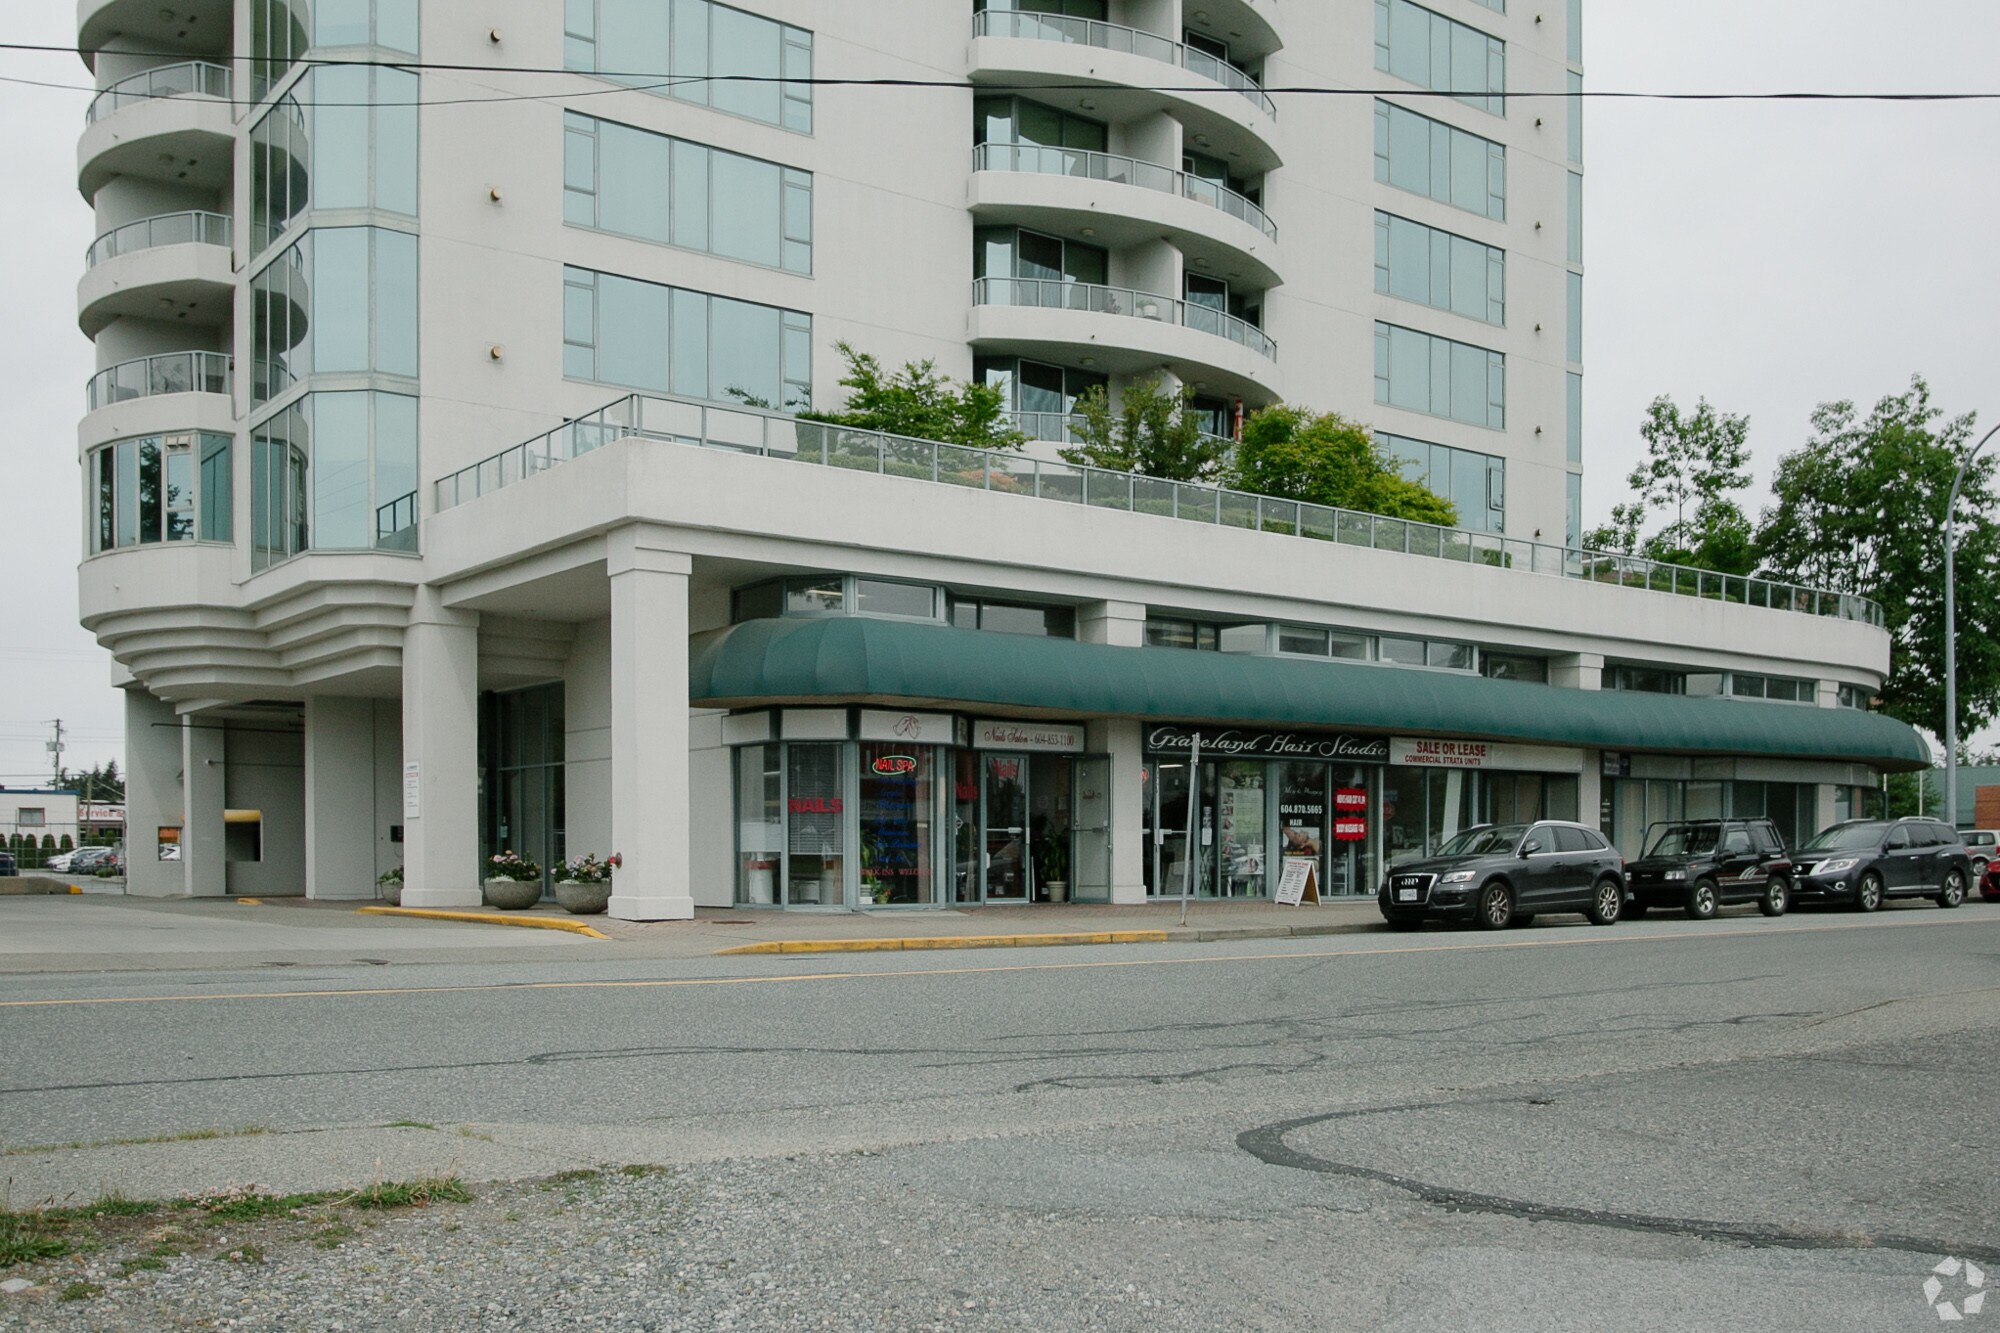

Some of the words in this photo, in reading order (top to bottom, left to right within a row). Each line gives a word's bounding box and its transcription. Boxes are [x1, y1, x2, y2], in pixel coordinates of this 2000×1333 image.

[1149, 727, 1271, 754] Graeland
[1265, 734, 1319, 753] Hair
[1319, 734, 1387, 756] Studio
[1416, 741, 1440, 754] SALE
[1442, 742, 1455, 755] OR
[1458, 743, 1486, 756] LEASE
[875, 758, 894, 771] NAIL
[896, 759, 914, 772] SPA
[1405, 755, 1441, 764] COMMERCIAL
[1443, 756, 1463, 765] STRATA
[1465, 757, 1481, 766] UNITS
[788, 797, 843, 813] NAILS
[1280, 804, 1322, 815] 604.870.5665
[79, 808, 113, 817] Srvice
